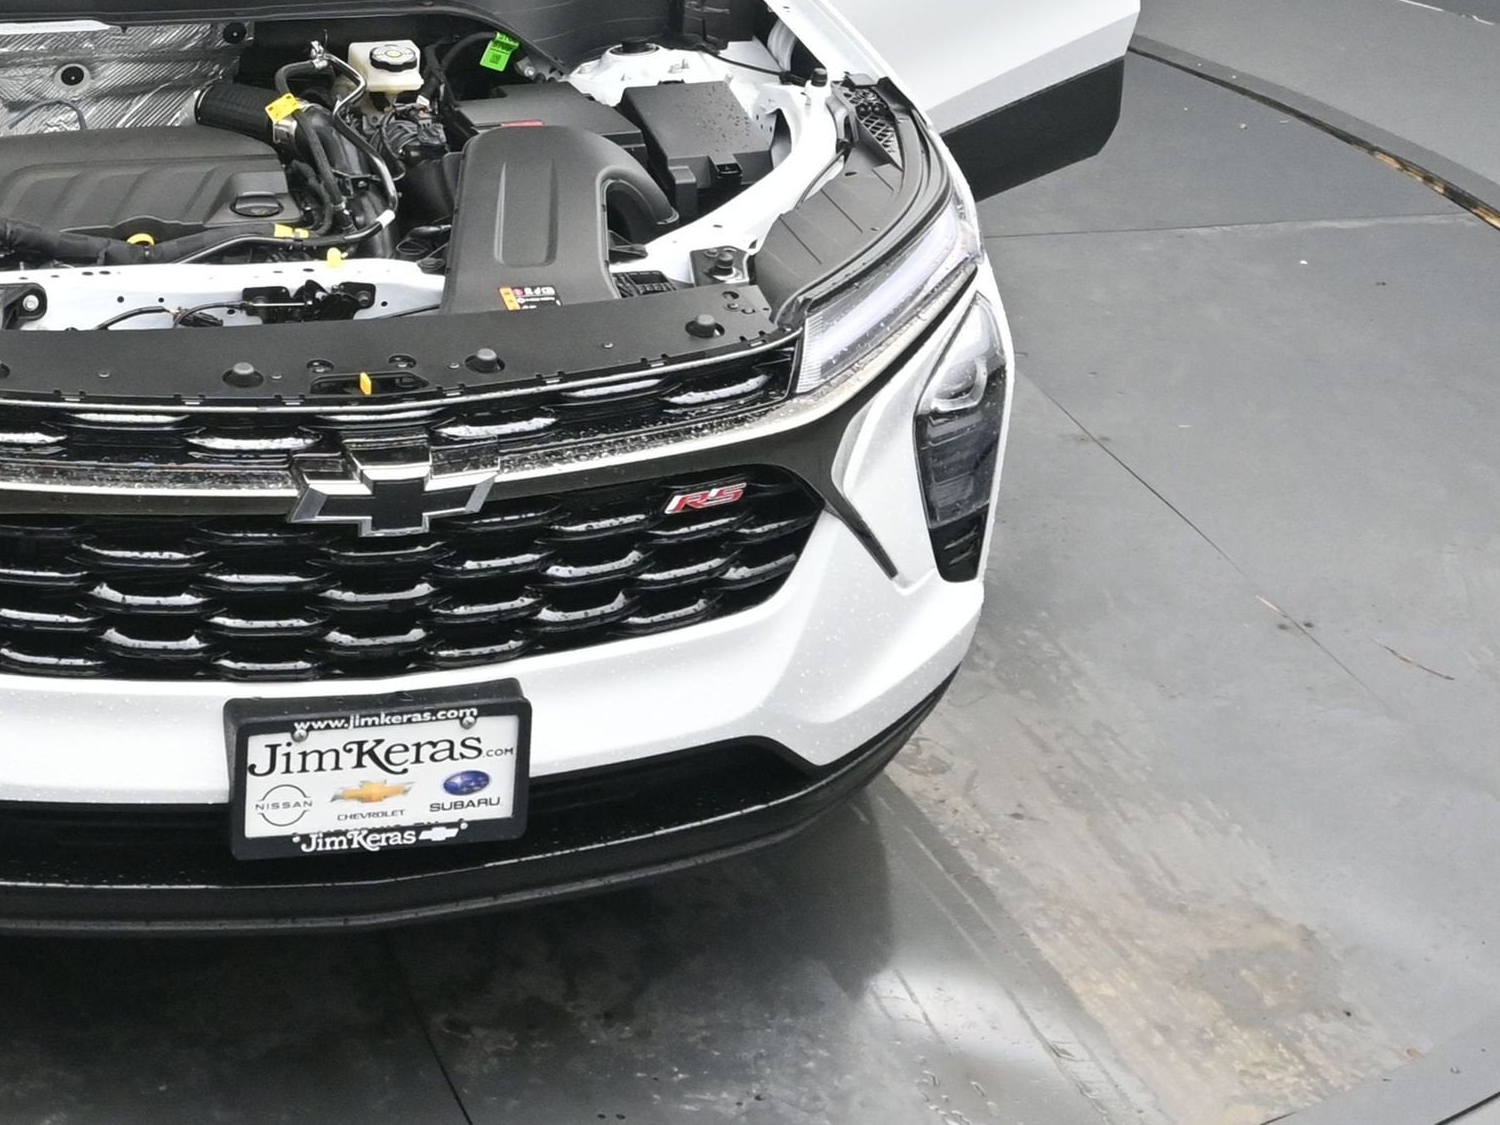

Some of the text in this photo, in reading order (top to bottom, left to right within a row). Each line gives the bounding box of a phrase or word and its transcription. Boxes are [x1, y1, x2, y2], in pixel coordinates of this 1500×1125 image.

[664, 482, 747, 515] RS
[293, 707, 478, 730] www.jimkeras.com
[255, 800, 313, 811] NISSAN
[429, 796, 501, 812] SUBARU
[337, 809, 405, 821] CHEVROLET
